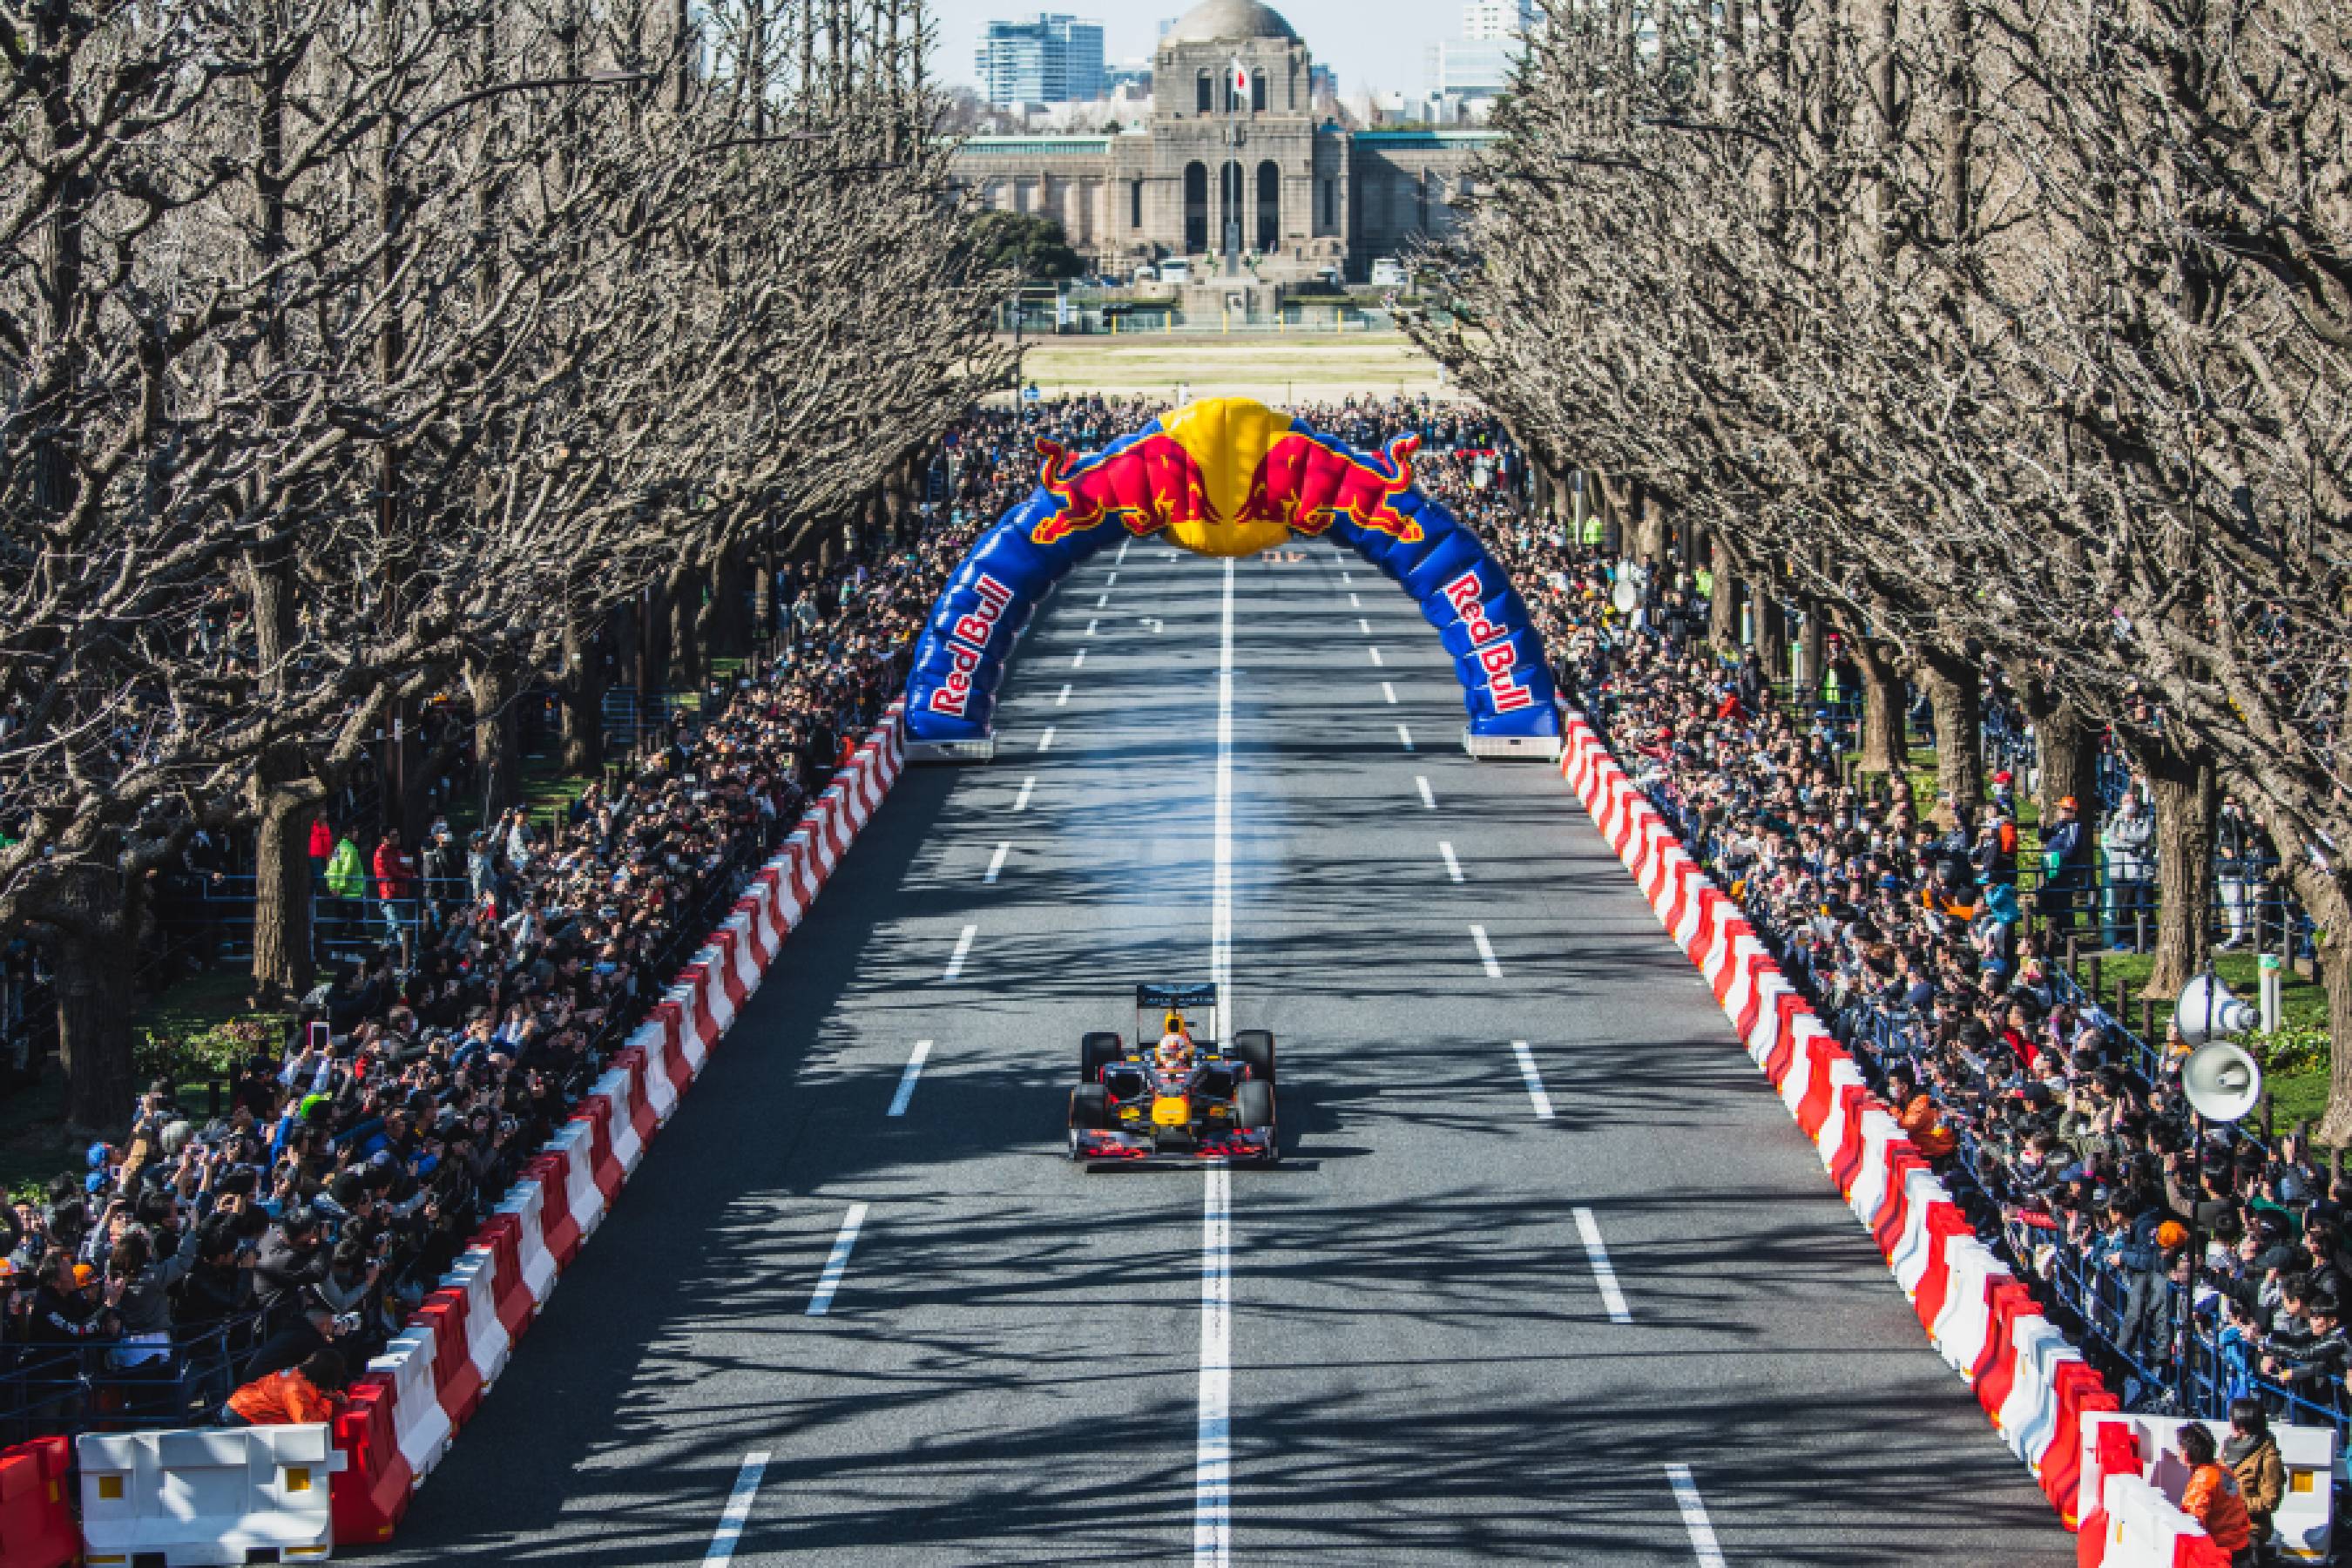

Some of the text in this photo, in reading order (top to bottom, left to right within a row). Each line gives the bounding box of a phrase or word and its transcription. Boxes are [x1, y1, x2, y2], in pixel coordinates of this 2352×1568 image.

[929, 573, 1014, 716] Red Bull
[1445, 571, 1533, 713] Red Bull
